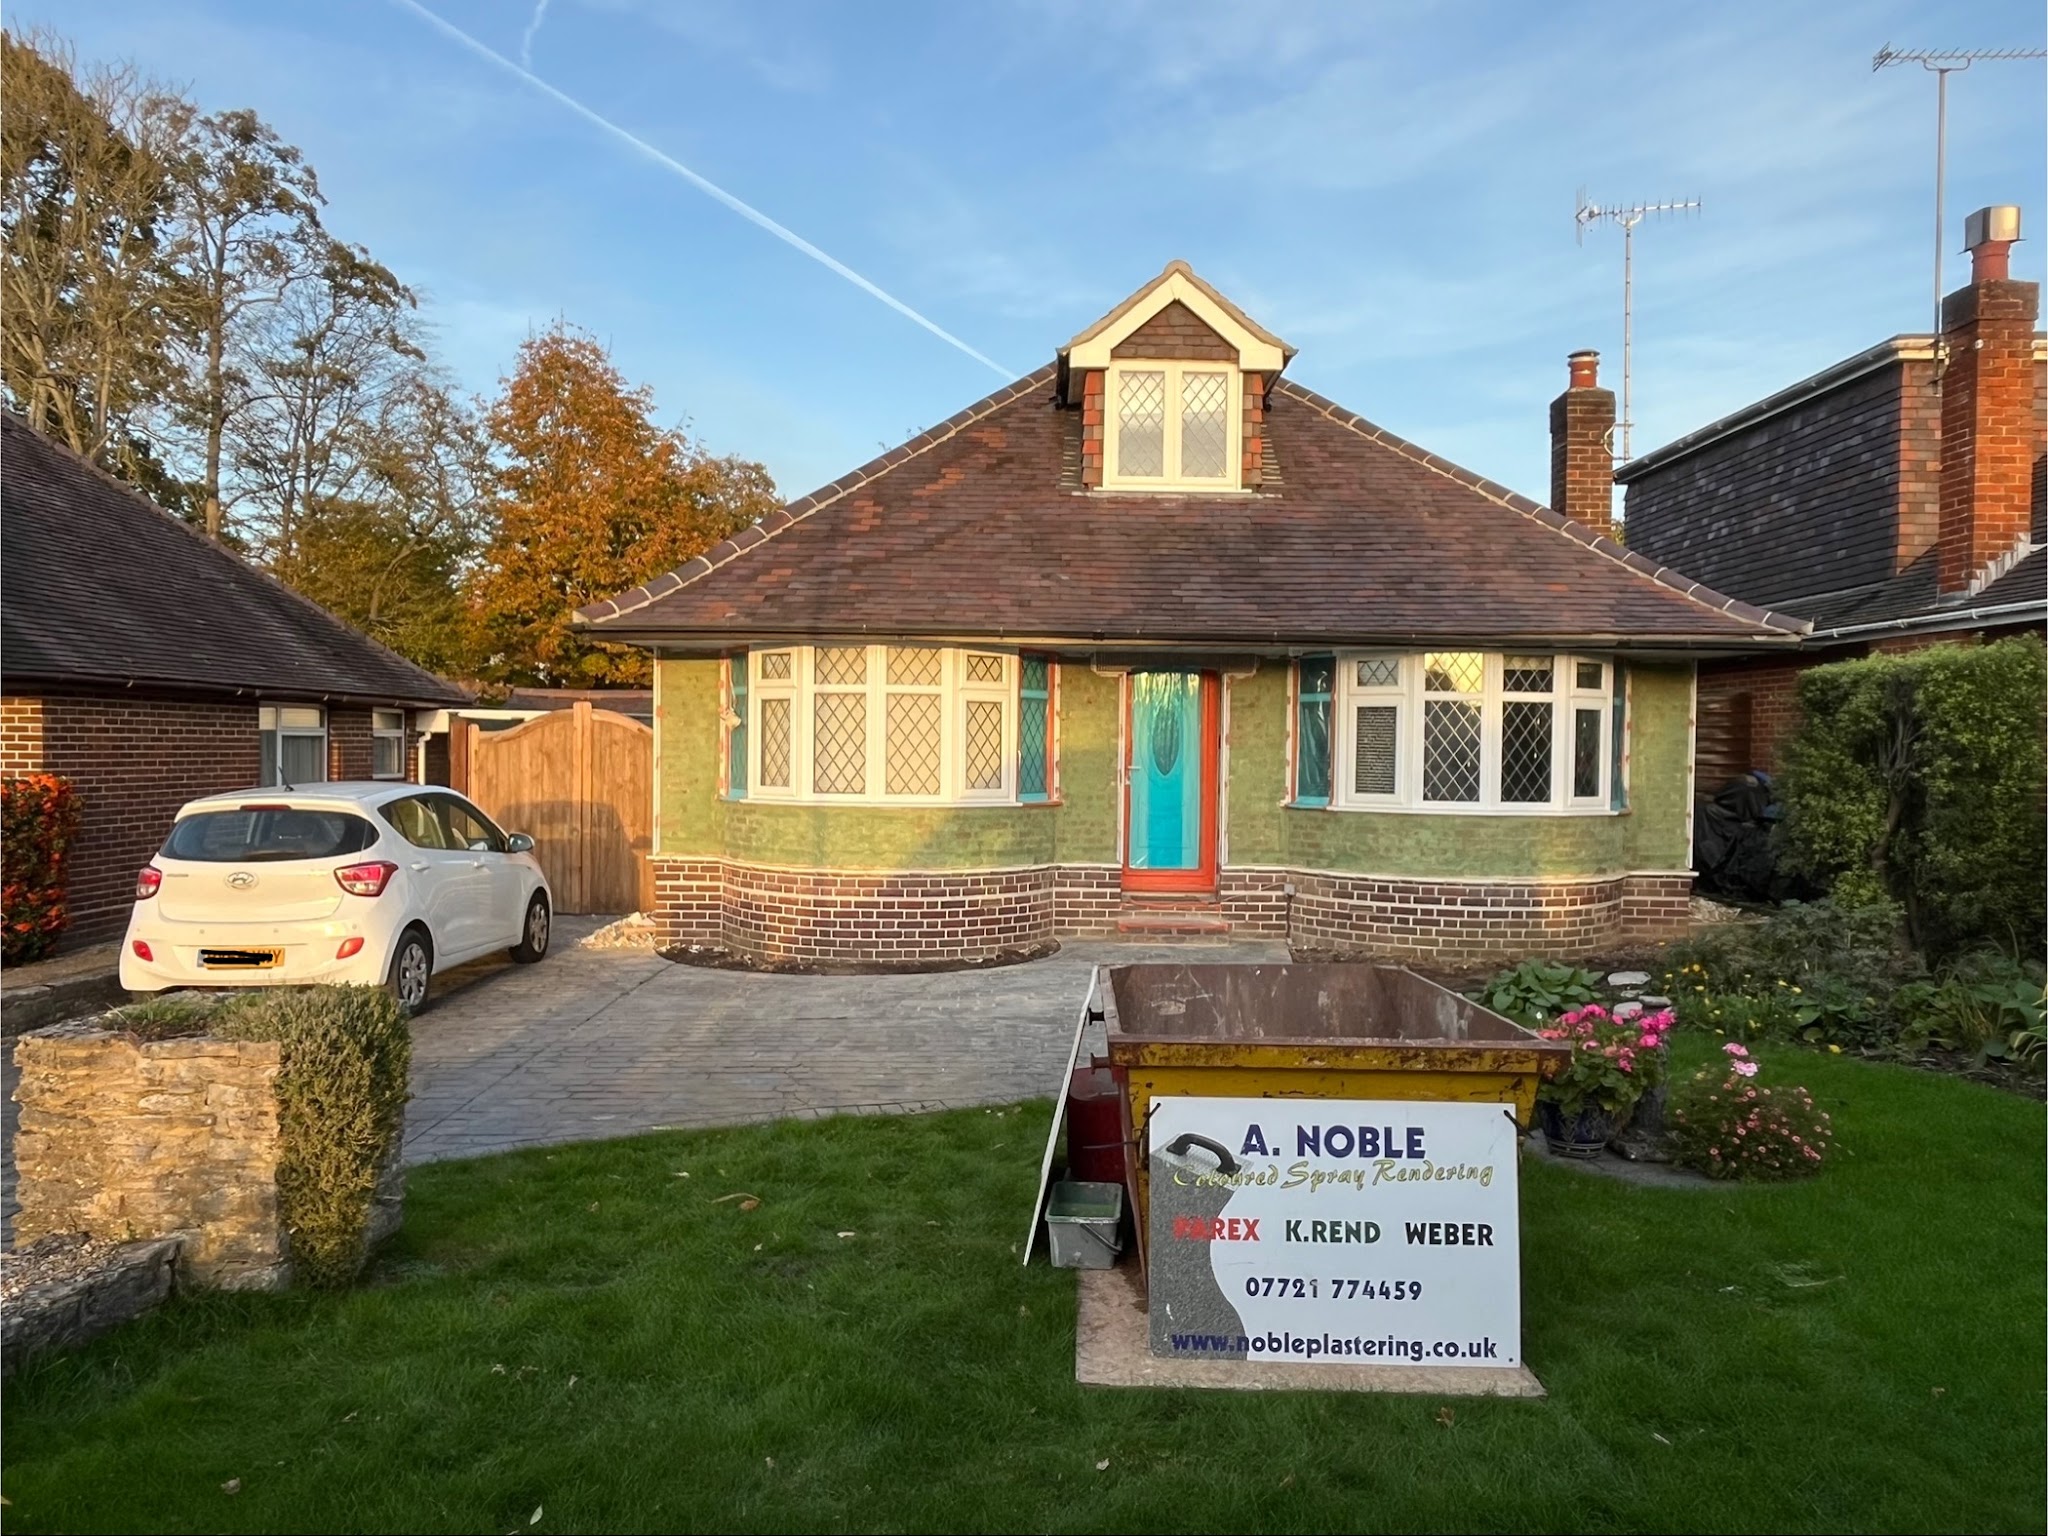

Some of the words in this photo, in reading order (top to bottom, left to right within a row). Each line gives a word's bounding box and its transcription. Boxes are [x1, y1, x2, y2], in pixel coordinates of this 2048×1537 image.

[1240, 1124, 1280, 1156] A.
[1297, 1125, 1426, 1158] NOBLE
[1173, 1163, 1279, 1187] Coloured
[1280, 1161, 1365, 1193] Spray
[1372, 1159, 1493, 1187] Rendering
[1172, 1216, 1260, 1242] PAREX
[1286, 1219, 1381, 1243] K.REND
[1405, 1222, 1494, 1246] WEBER
[1245, 1277, 1318, 1298] 07721
[1332, 1279, 1422, 1301] 774459
[1172, 1332, 1497, 1362] www.nobleplastering.co.uk
